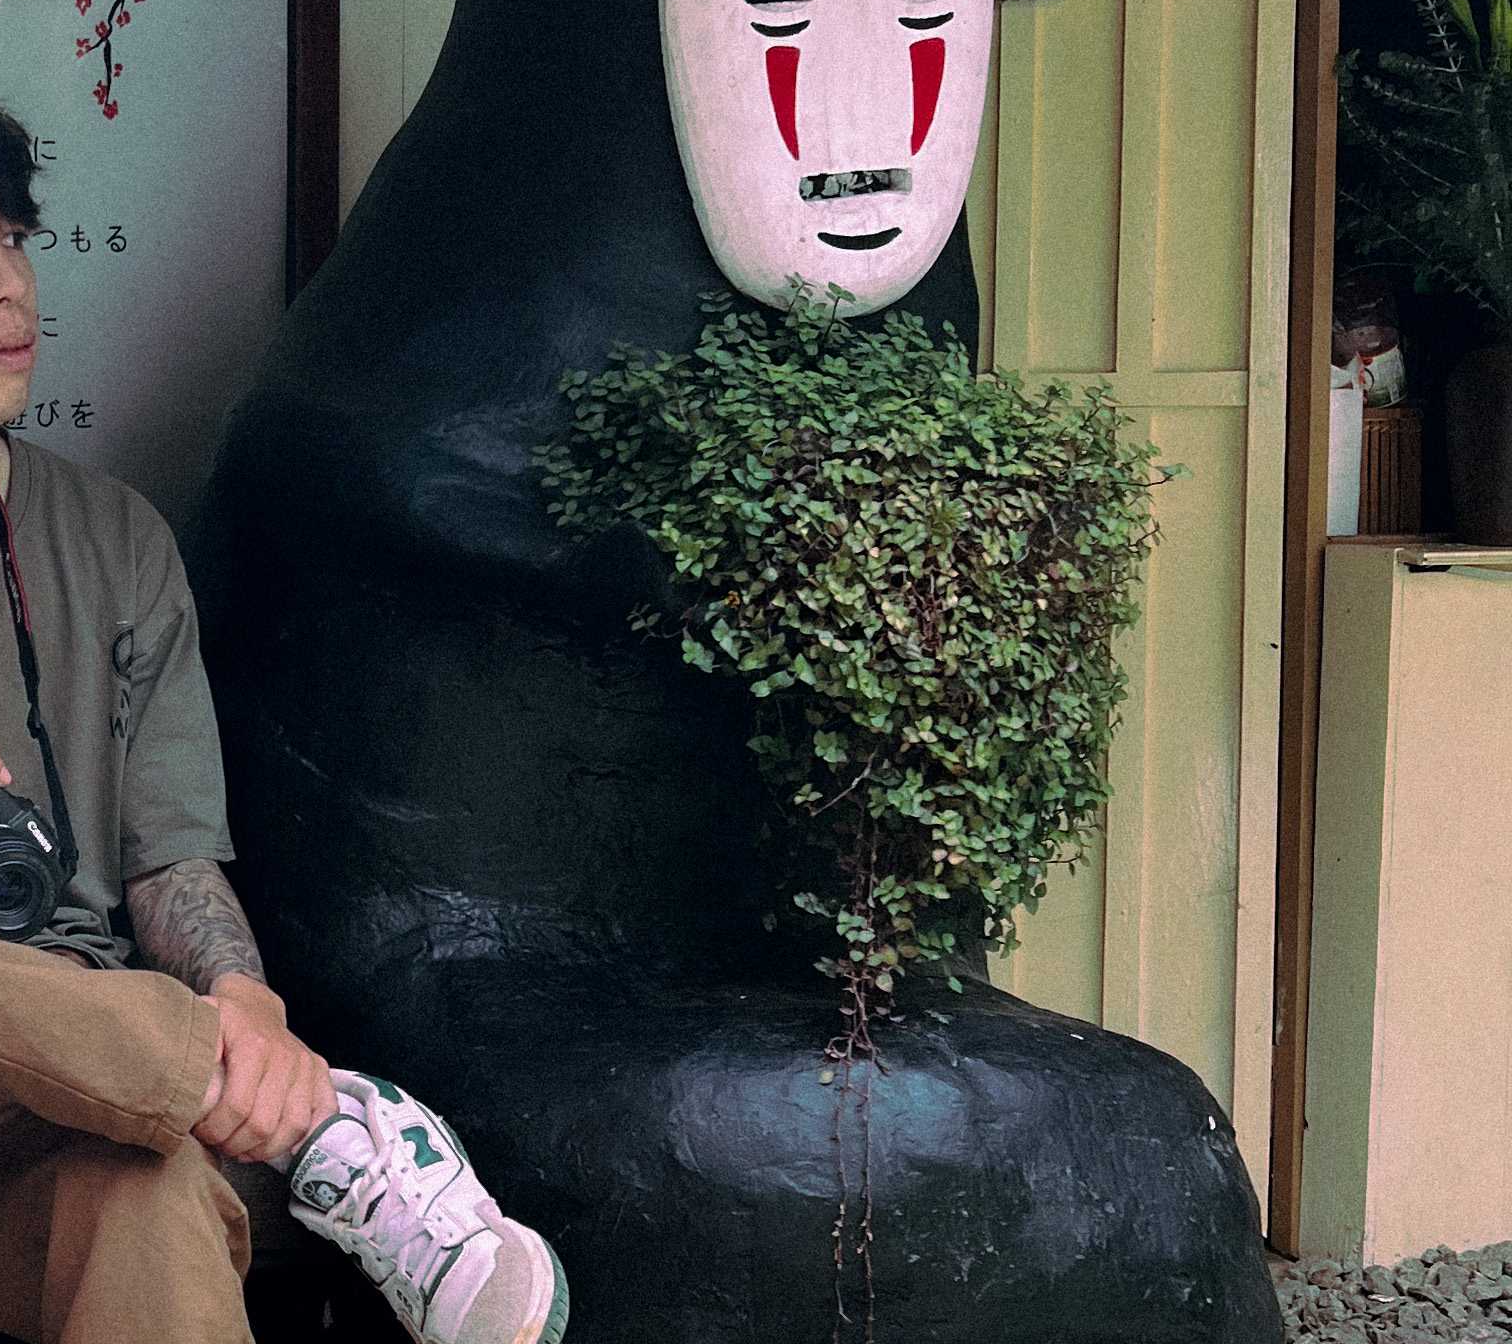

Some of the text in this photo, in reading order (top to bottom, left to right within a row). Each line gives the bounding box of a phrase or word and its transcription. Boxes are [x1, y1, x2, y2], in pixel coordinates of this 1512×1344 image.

[33, 224, 128, 253] つもる
[27, 820, 53, 853] Canon
